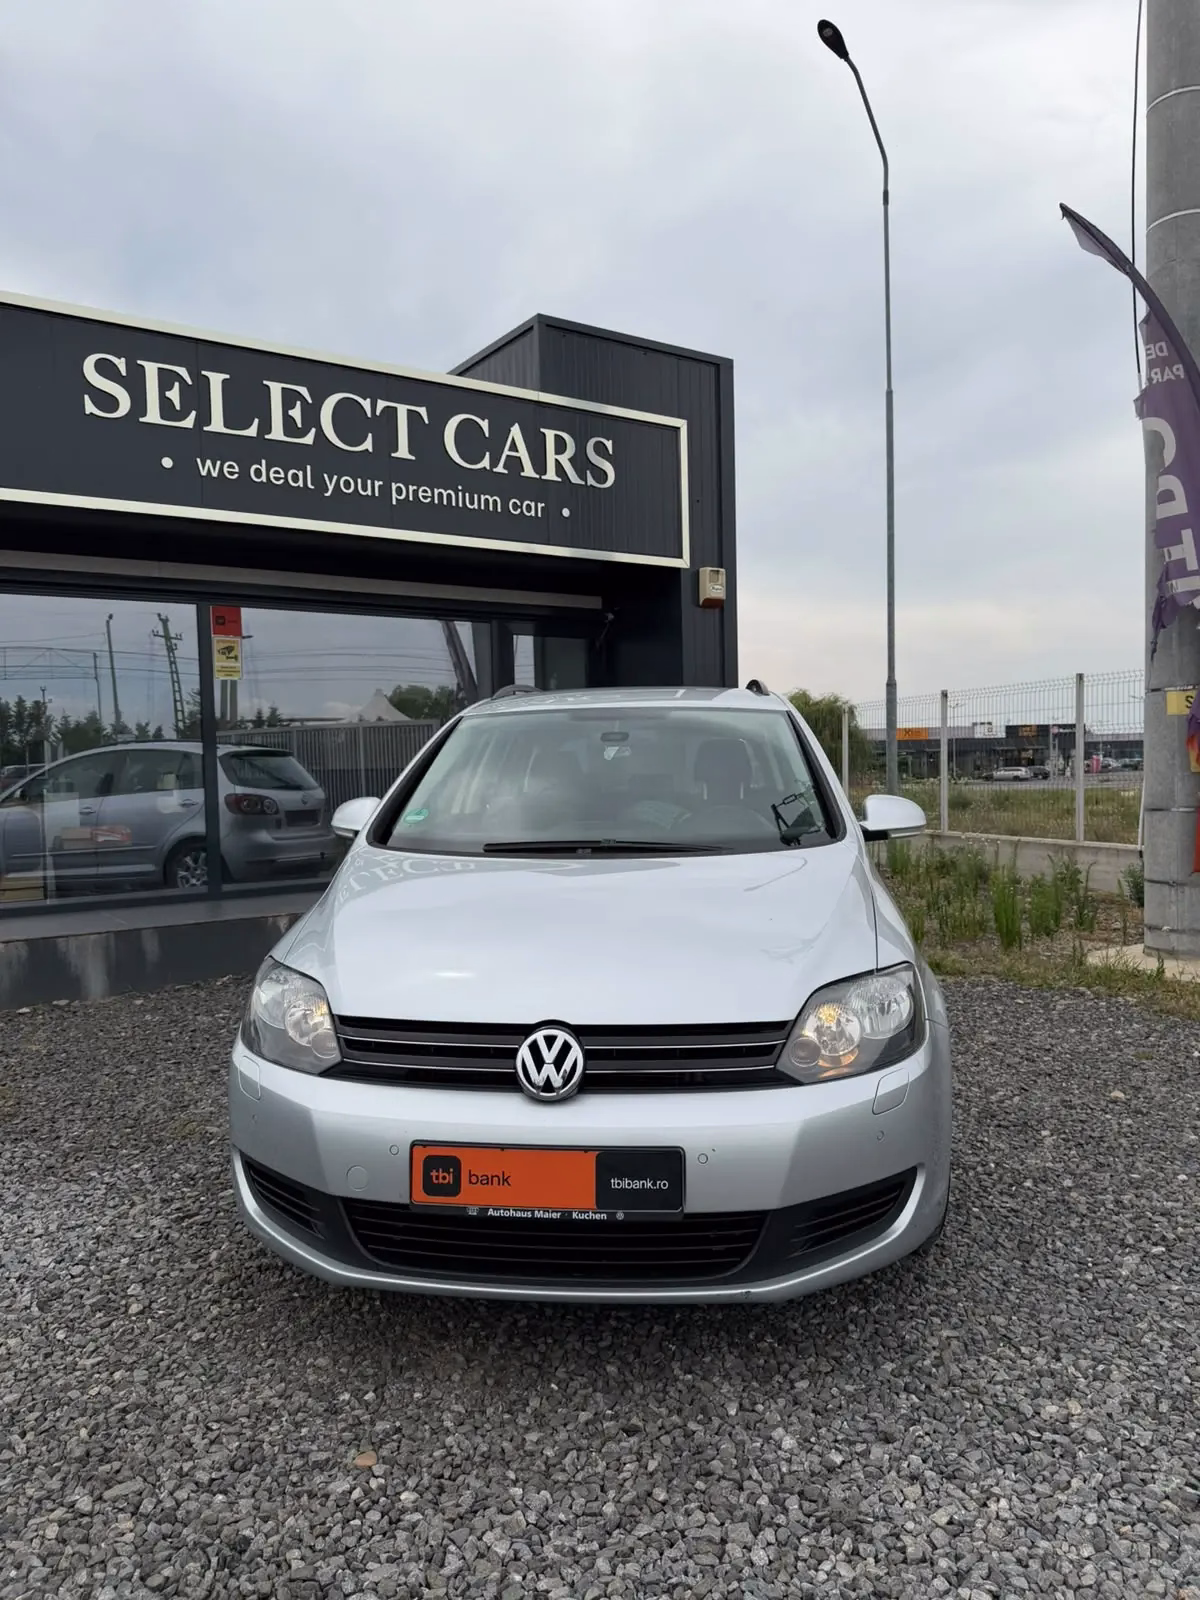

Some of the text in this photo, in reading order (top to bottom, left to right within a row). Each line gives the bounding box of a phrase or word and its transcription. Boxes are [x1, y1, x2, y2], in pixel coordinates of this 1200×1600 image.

[82, 352, 616, 489] SELECT CARS
[197, 457, 546, 518] we deal your premium car
[430, 1168, 512, 1188] tbi bank
[610, 1177, 669, 1191] tbibank.ro
[487, 1207, 608, 1221] Autohaus Maier Kuchen
